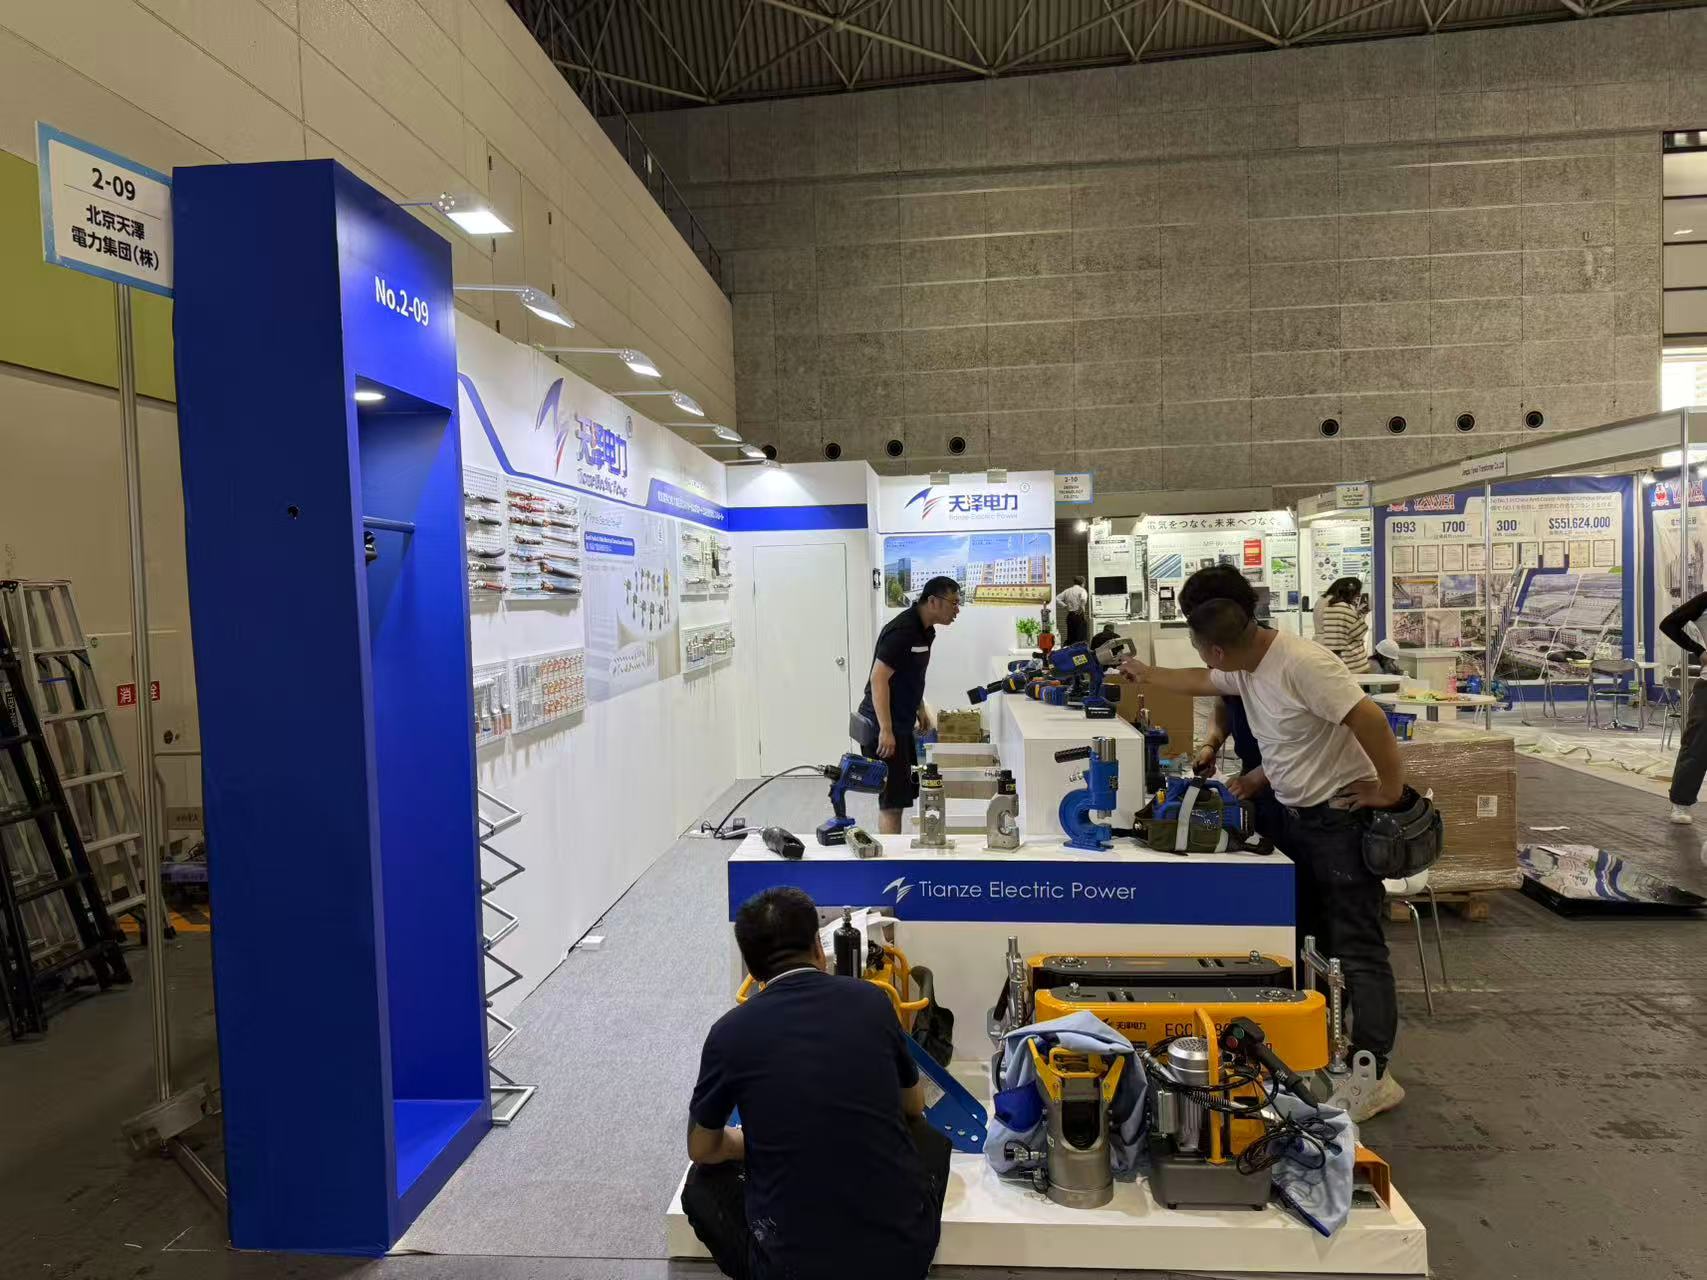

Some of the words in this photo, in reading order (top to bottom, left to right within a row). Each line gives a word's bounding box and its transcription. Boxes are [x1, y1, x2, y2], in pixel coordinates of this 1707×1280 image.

[92, 168, 136, 200] 2-09
[86, 205, 145, 240] 北京天澤
[375, 275, 429, 327] No.2-09
[949, 494, 1018, 513] 天泽电力
[1391, 521, 1417, 533] 1993
[1442, 520, 1466, 533] 1700
[1496, 519, 1518, 531] 300
[919, 881, 981, 897] Tianze
[990, 881, 1064, 898] Electric
[1072, 882, 1137, 900] Power
